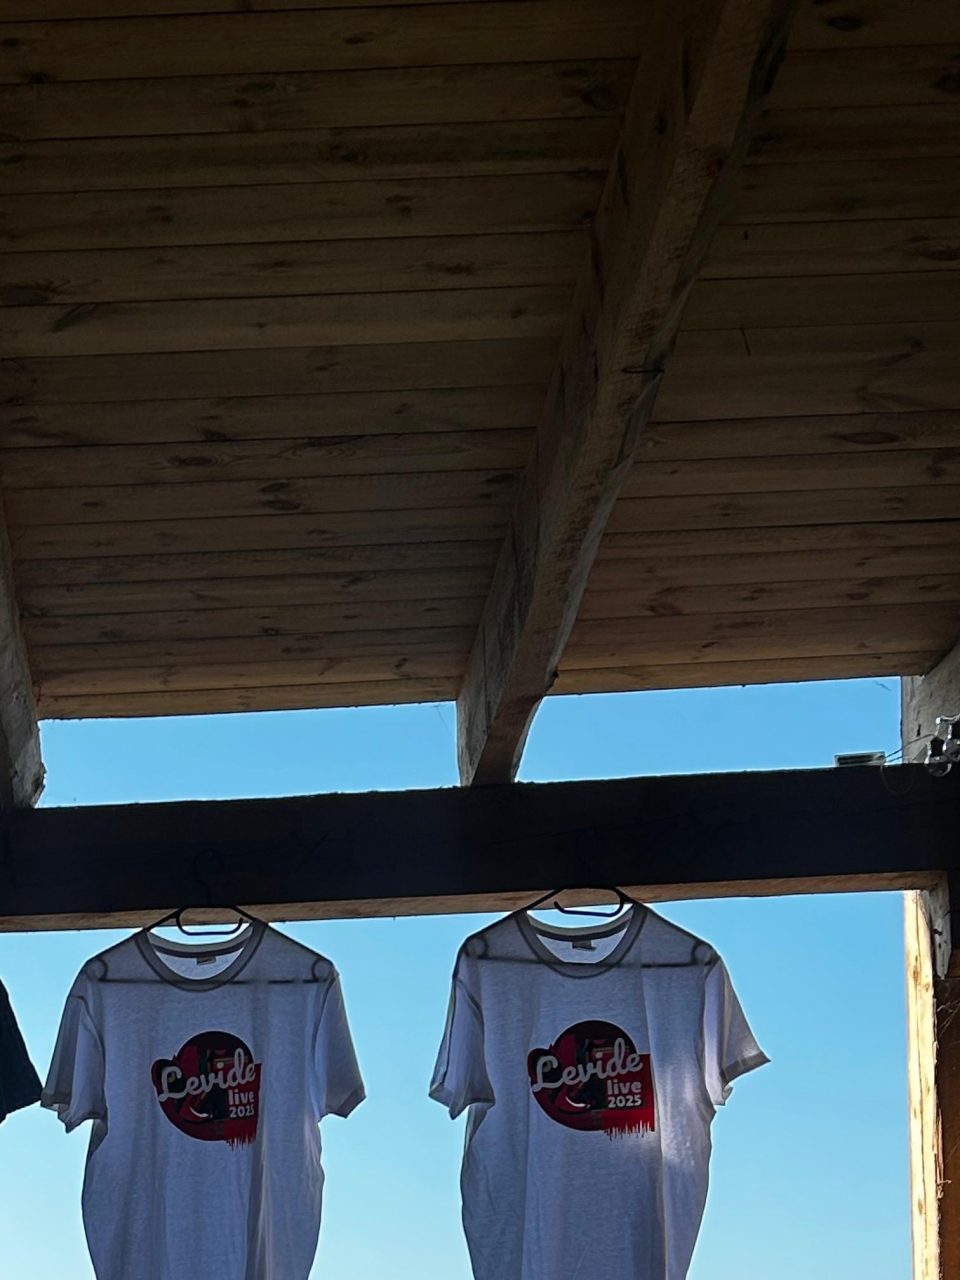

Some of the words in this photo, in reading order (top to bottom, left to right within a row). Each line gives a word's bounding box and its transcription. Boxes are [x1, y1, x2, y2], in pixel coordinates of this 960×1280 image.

[531, 1037, 644, 1093] Levide
[158, 1047, 257, 1102] Levide
[606, 1078, 642, 1095] live
[228, 1088, 255, 1105] live
[607, 1095, 642, 1109] 2025
[229, 1105, 255, 1118] 2025
